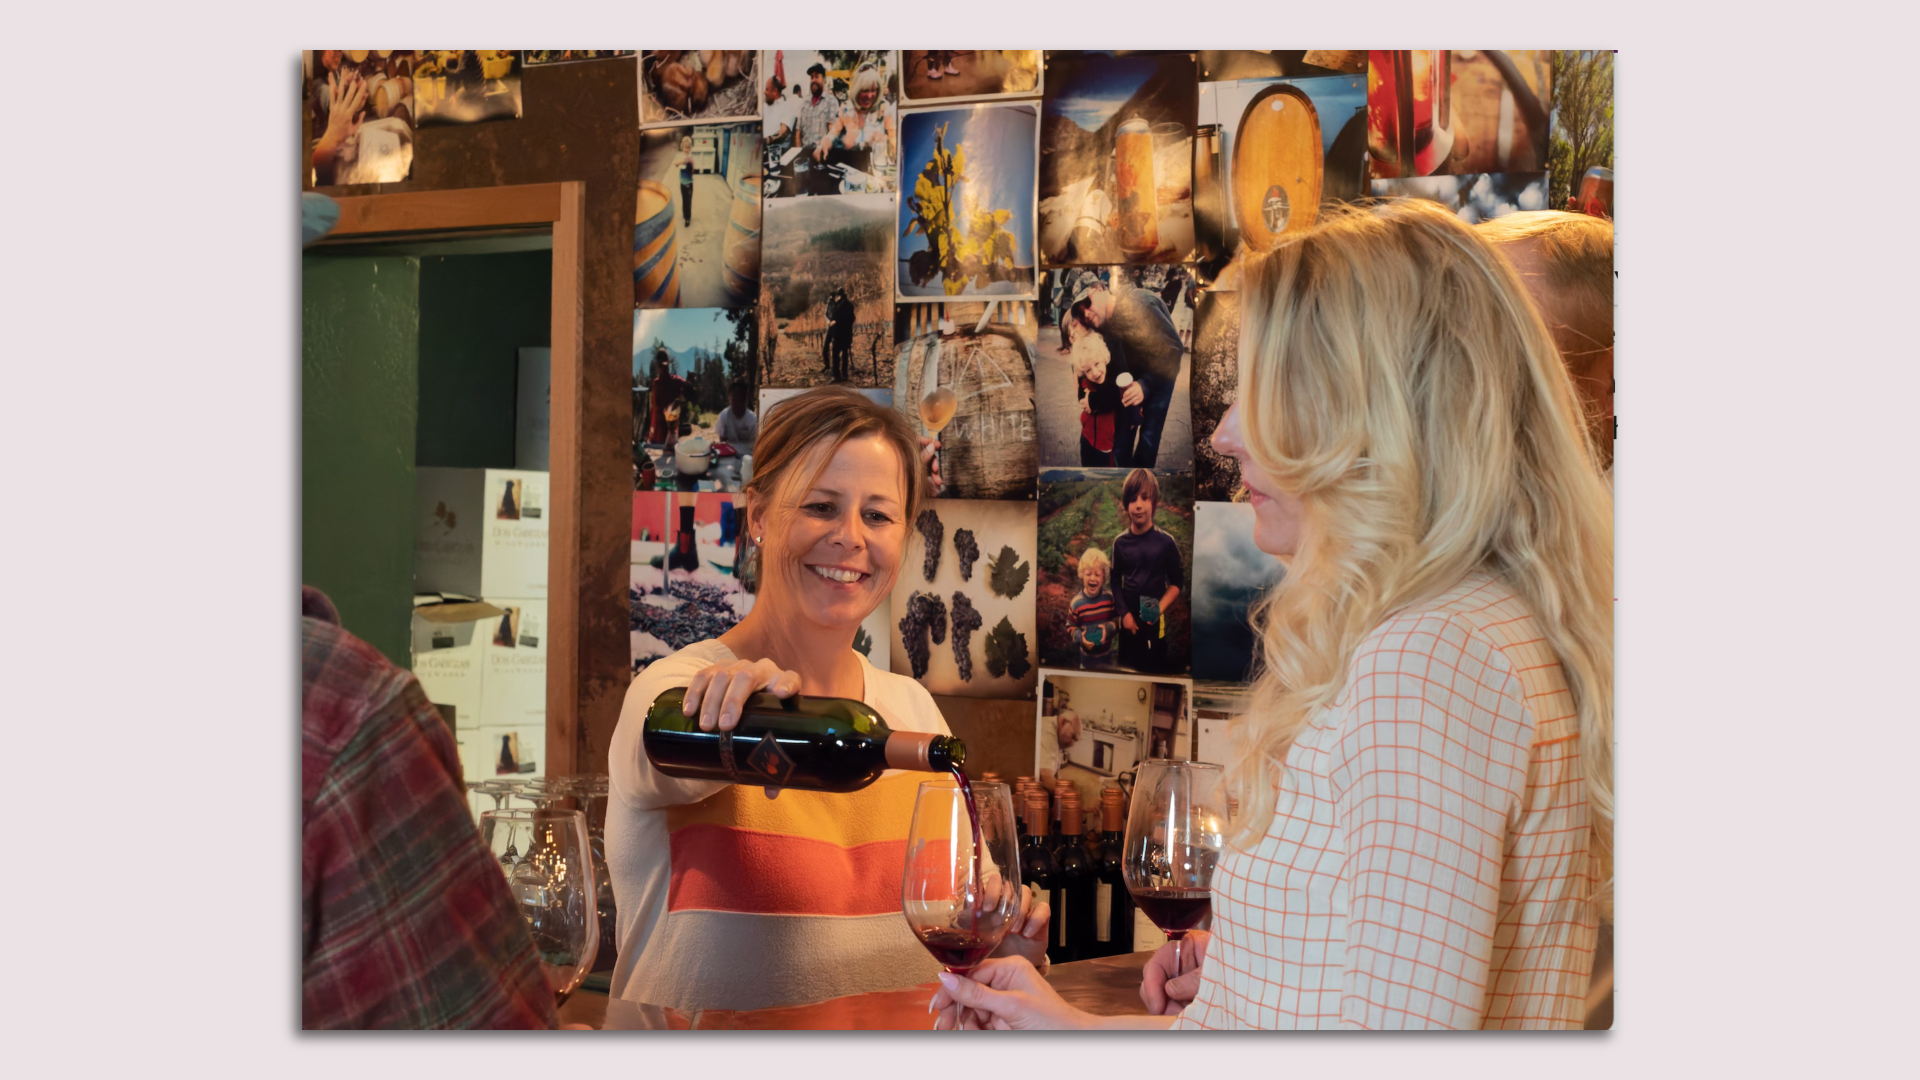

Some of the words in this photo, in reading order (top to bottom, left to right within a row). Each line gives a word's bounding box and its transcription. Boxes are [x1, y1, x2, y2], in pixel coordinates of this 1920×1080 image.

[953, 413, 1033, 445] WHITE
[512, 526, 547, 538] CABEZA
[511, 653, 546, 665] CABEZA
